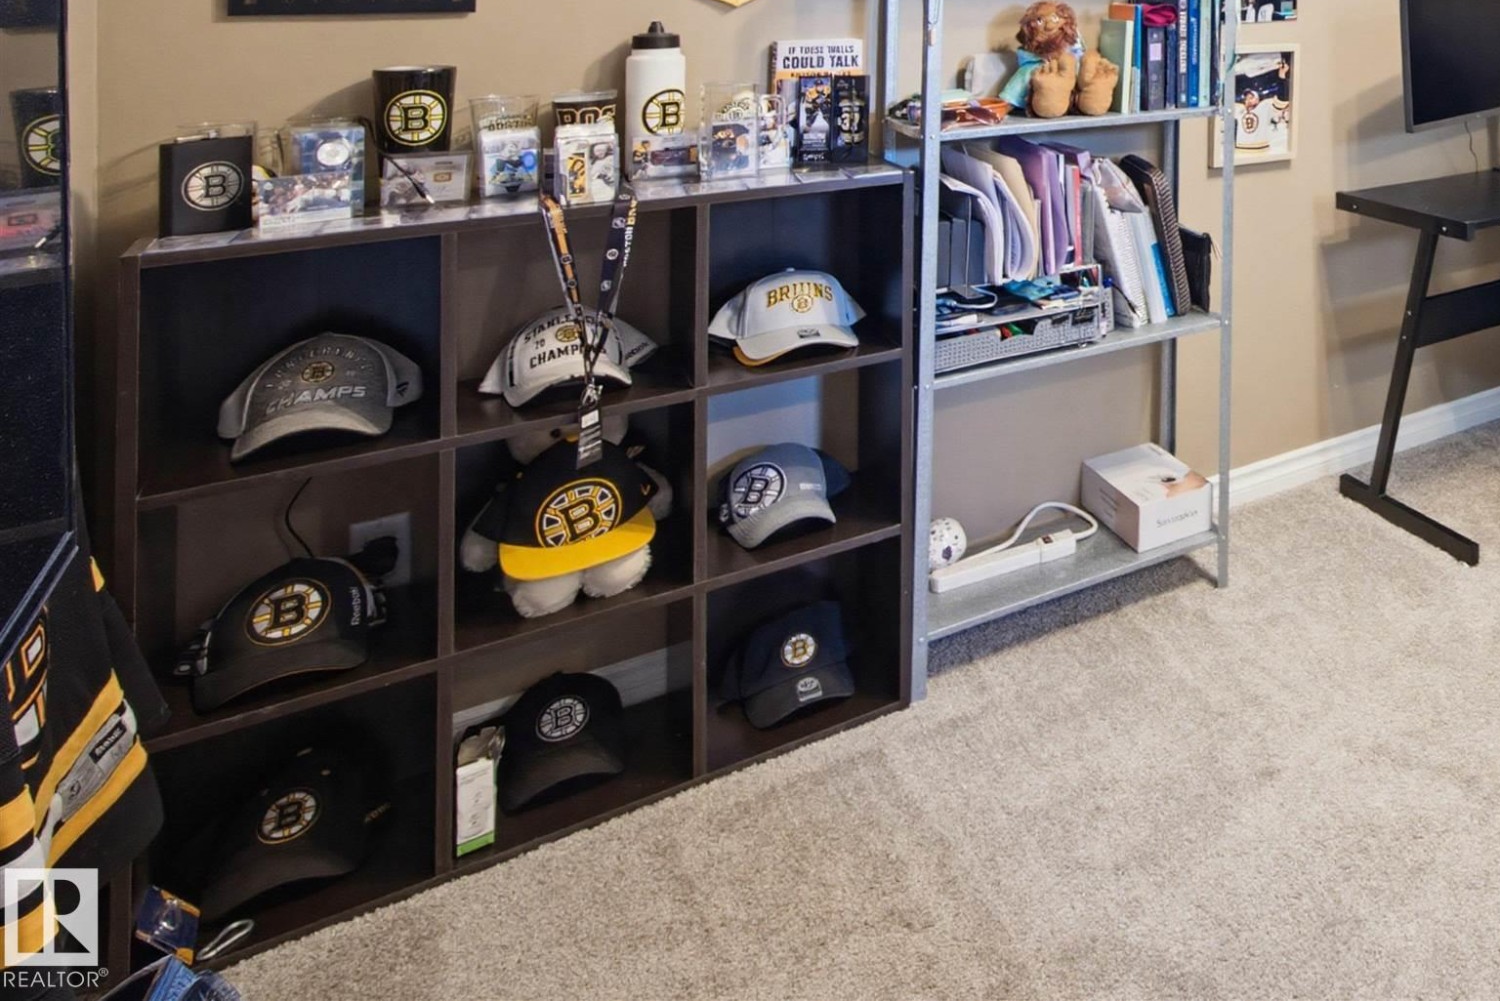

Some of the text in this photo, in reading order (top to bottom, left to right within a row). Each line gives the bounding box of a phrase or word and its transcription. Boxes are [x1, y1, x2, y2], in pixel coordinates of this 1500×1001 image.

[783, 55, 859, 69] COULD TALK
[788, 46, 796, 55] IF
[766, 281, 833, 309] BRUINS
[523, 313, 573, 344] STANLE
[265, 385, 367, 415] CHAMPS
